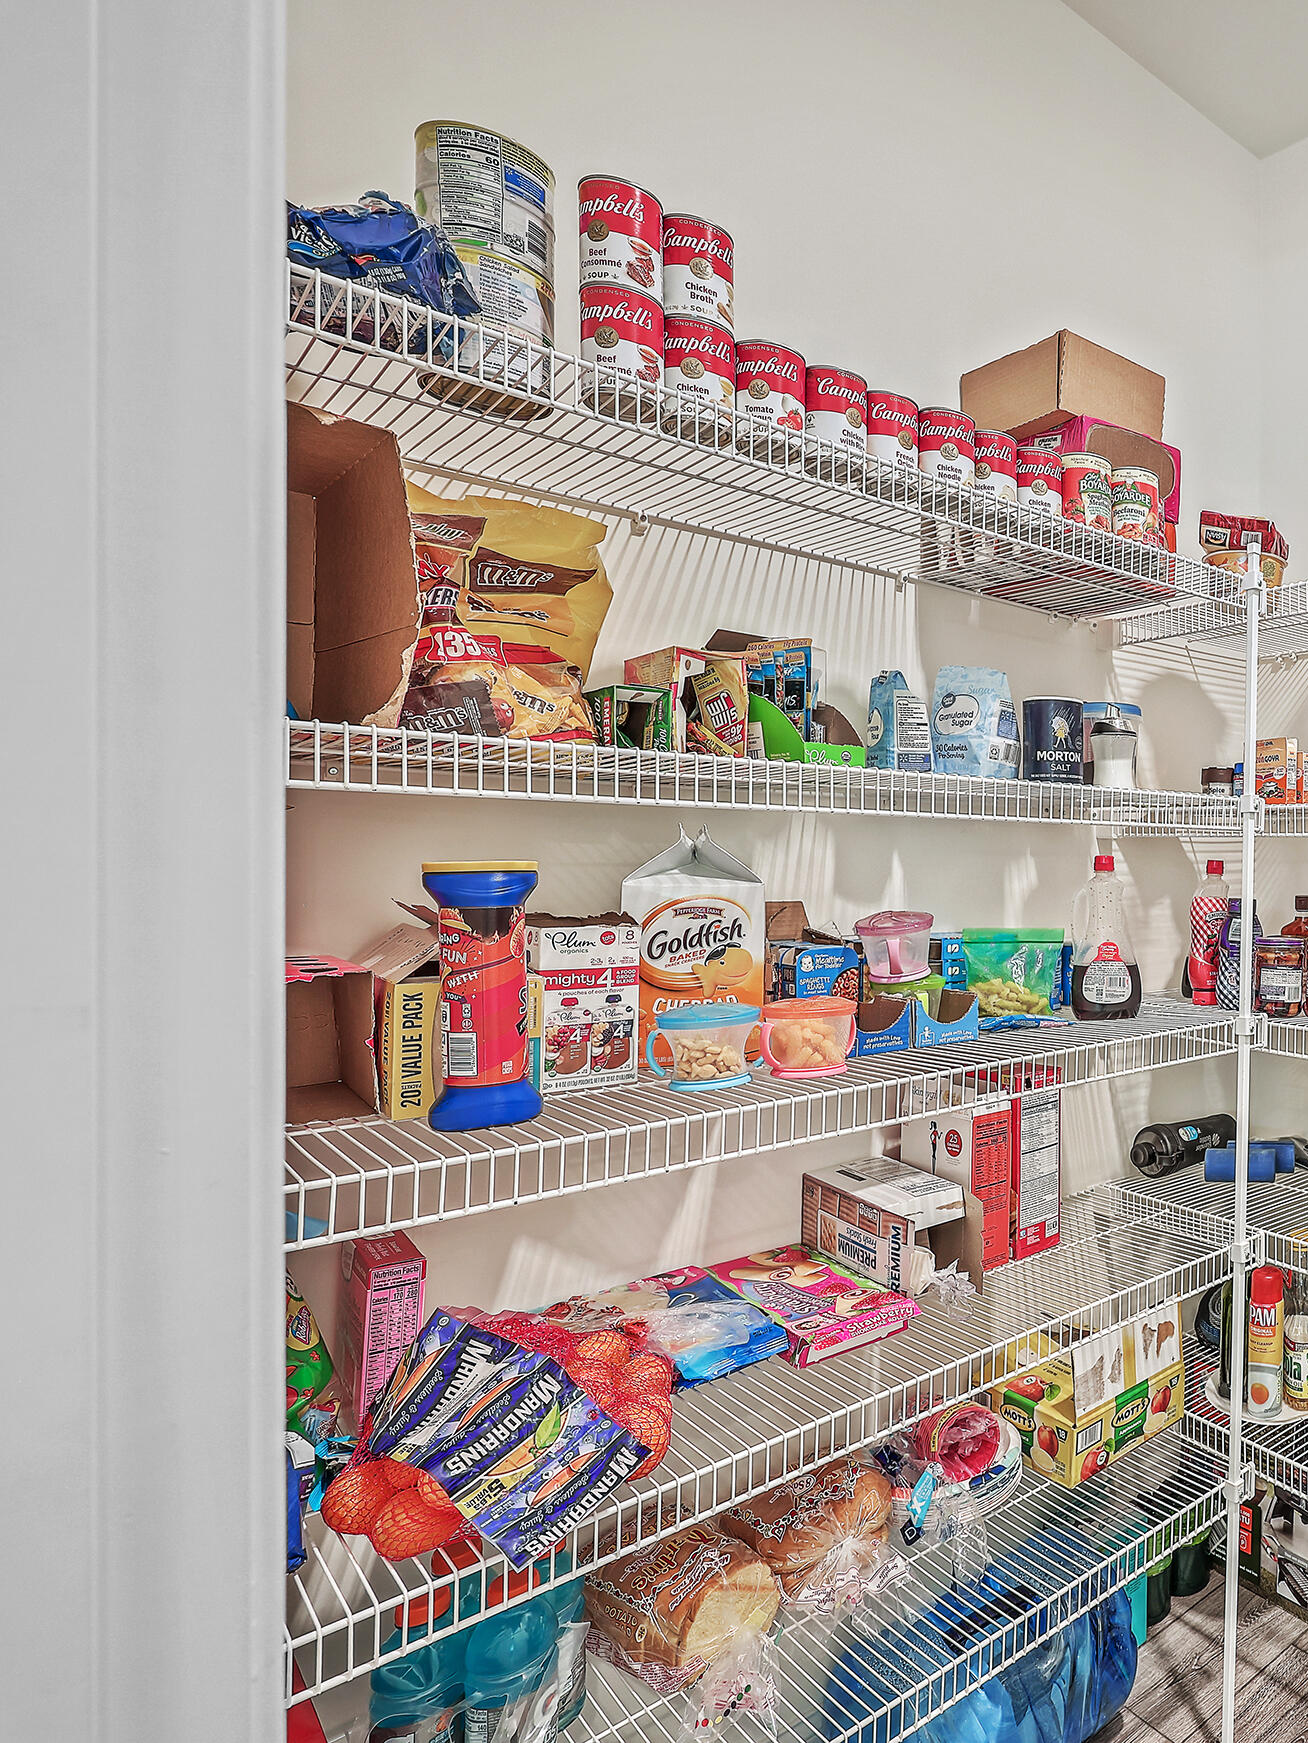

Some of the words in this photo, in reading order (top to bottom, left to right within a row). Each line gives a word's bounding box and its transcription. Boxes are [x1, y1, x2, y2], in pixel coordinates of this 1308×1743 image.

[437, 127, 472, 138] Nutrition
[474, 131, 499, 145] Facts
[439, 150, 471, 159] Calories
[485, 156, 500, 166] 60
[580, 194, 645, 224] ampbell's
[588, 248, 607, 257] Beef
[685, 282, 718, 298] Chicken
[690, 291, 714, 305] Broth
[596, 354, 616, 363] Beef
[676, 383, 709, 395] Chicken
[745, 405, 774, 414] Tomato
[840, 438, 855, 447] with
[842, 429, 864, 443] Chicken
[896, 451, 914, 463] French
[937, 464, 962, 474] Chicken
[938, 472, 961, 481] Noodle
[1028, 499, 1051, 508] Chicken
[967, 685, 996, 696] Sugar
[603, 697, 612, 747] EMERA
[938, 710, 975, 722] Granulated
[951, 718, 974, 728] Sugar
[944, 743, 968, 753] Calories
[1036, 750, 1081, 763] MORTON
[1051, 763, 1072, 772] SALT
[676, 907, 705, 916] PEPPERIDGE
[706, 908, 722, 916] FARM
[440, 933, 460, 945] RING
[545, 931, 596, 950] Plum
[625, 930, 635, 940] 8
[647, 917, 747, 960] Goldfish
[442, 948, 467, 965] FUN
[669, 949, 707, 963] BAKED
[447, 971, 480, 988] WITH
[544, 974, 596, 988] mighty
[597, 968, 615, 988] 4
[402, 992, 424, 1029] PACK
[401, 1034, 422, 1079] VALUE
[949, 1134, 959, 1143] 25
[861, 1235, 877, 1249] Fresh
[837, 1238, 877, 1270] PREMIUM
[891, 1225, 901, 1293] REMIUM
[373, 1266, 402, 1279] Nutrition
[402, 1264, 420, 1273] Facts
[846, 1306, 914, 1334] Strawberry
[1250, 1305, 1276, 1327] PAM
[1003, 1408, 1034, 1430] MOTT'S
[1115, 1400, 1149, 1424] MOTT'S
[446, 1373, 562, 1477] MANDARINS
[1058, 1430, 1067, 1439] 18
[526, 1446, 640, 1558] MANDARINS
